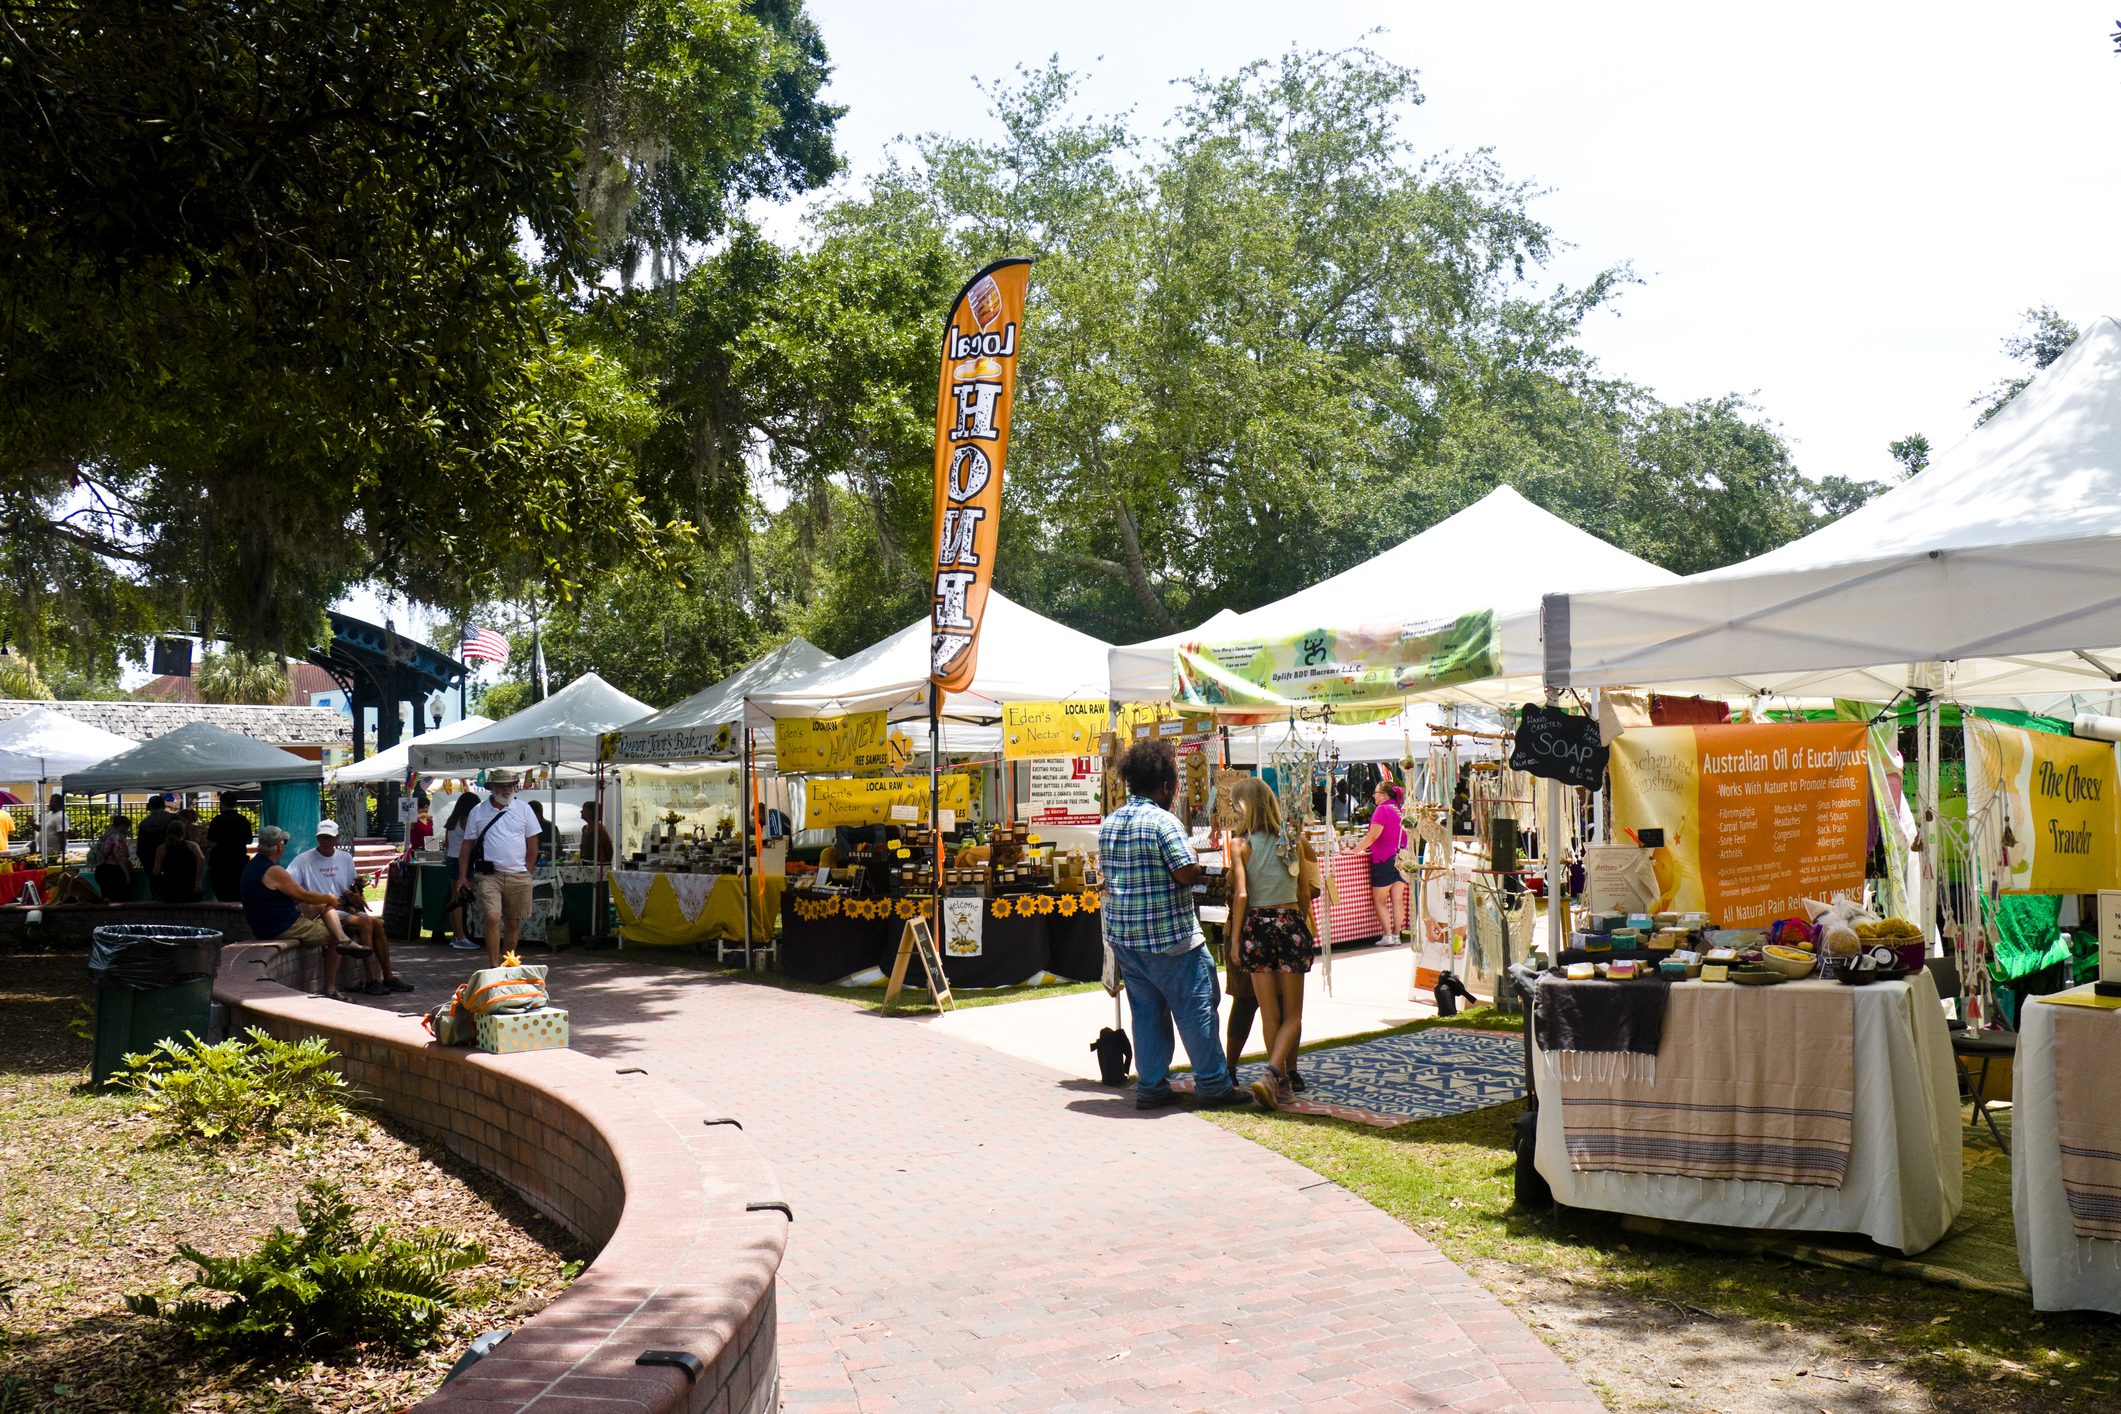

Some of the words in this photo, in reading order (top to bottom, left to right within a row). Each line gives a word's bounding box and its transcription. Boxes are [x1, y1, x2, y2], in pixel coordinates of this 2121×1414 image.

[1272, 672, 1293, 681] Uplift
[1294, 670, 1309, 679] BDV
[1310, 668, 1340, 677] Macrame
[1065, 704, 1087, 715] LOCAL
[1090, 703, 1105, 714] RAW
[1009, 707, 1051, 726] Eden's
[1526, 715, 1547, 725] HAND
[778, 723, 803, 740] Eden's
[1530, 721, 1562, 733] CRAFTED
[619, 735, 647, 754] Sweet
[674, 728, 713, 754] Bakery
[826, 713, 879, 768] HONEY
[1531, 732, 1594, 763] SOAP
[466, 751, 481, 763] The
[482, 749, 505, 762] World
[865, 754, 888, 766] SAMPLES
[1516, 751, 1527, 760] NO
[1703, 748, 1769, 775] Australian
[1772, 747, 1788, 771] Oil
[1792, 746, 1804, 769] of
[1807, 746, 1867, 771] Eucalyptus
[1716, 783, 1743, 797] -Works
[1744, 781, 1762, 795] With
[1764, 780, 1788, 794] Nature
[1790, 779, 1798, 791] to
[1800, 778, 1827, 791] Promote
[1828, 775, 1859, 791] Healing-
[2038, 760, 2063, 799] The
[813, 784, 853, 801] Eden's
[866, 781, 887, 792] LOCAL
[888, 781, 904, 791] RAW
[1793, 802, 1808, 812] Aches
[1831, 797, 1861, 809] Problems
[1219, 816, 1239, 827] HON
[1829, 811, 1849, 822] Spurs
[1739, 818, 1758, 831] Tunnel
[1832, 823, 1847, 833] Pain
[1734, 834, 1746, 844] Feet
[2048, 817, 2093, 855] Traveler
[946, 900, 980, 912] welcome
[1723, 905, 1734, 923] All
[1736, 900, 1766, 921] Natural
[1768, 896, 1785, 914] Pain
[1819, 890, 1828, 904] IT
